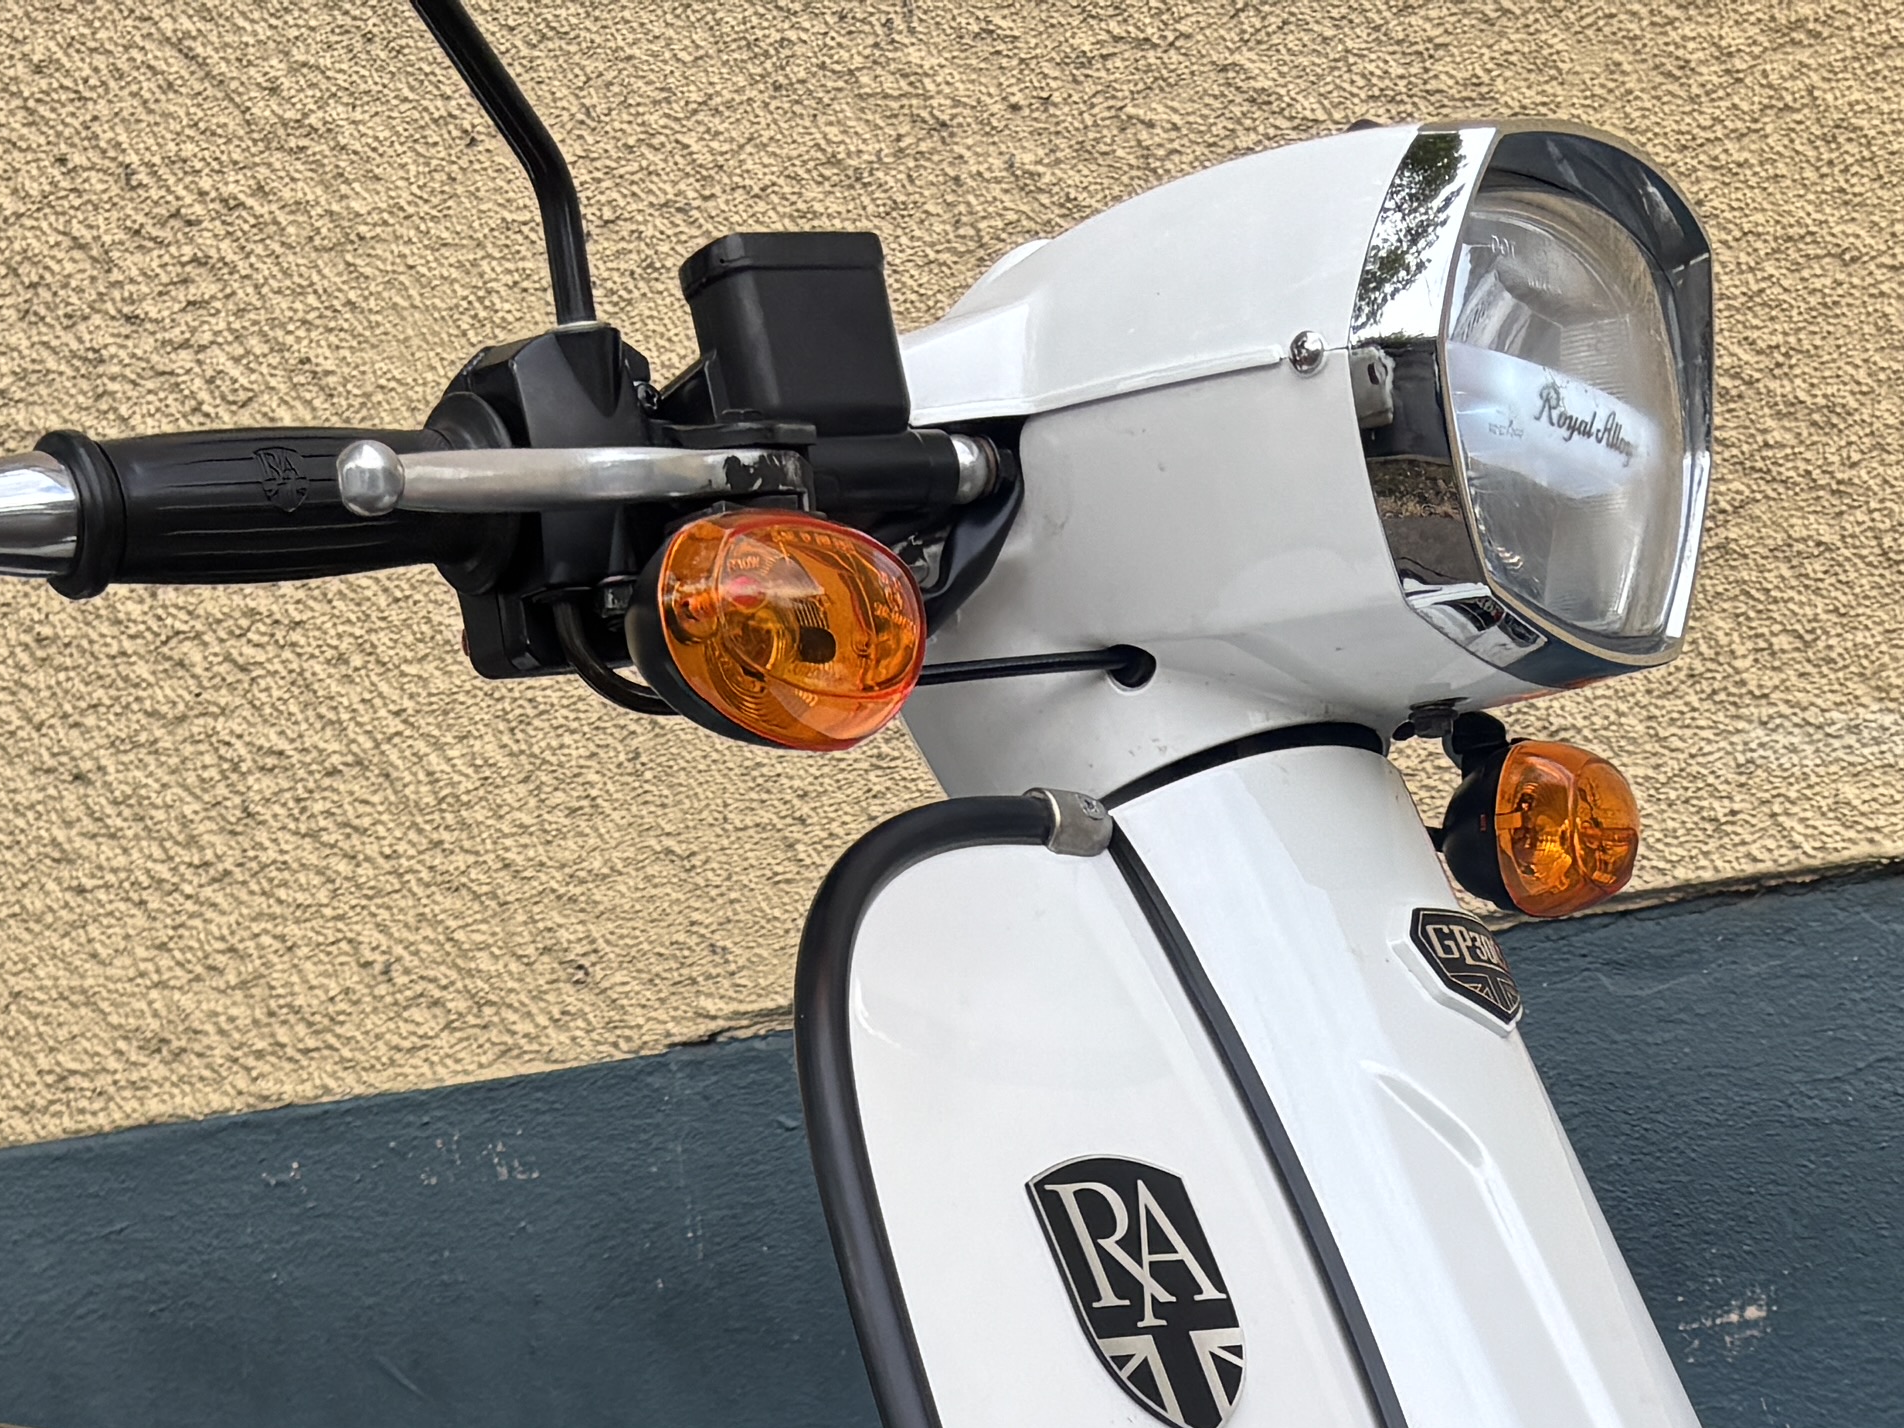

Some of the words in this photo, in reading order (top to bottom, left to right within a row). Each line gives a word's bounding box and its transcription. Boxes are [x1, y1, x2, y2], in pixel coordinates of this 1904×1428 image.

[1534, 384, 1596, 442] Royal
[1595, 411, 1634, 468] Alloy
[1044, 1179, 1228, 1328] RA
